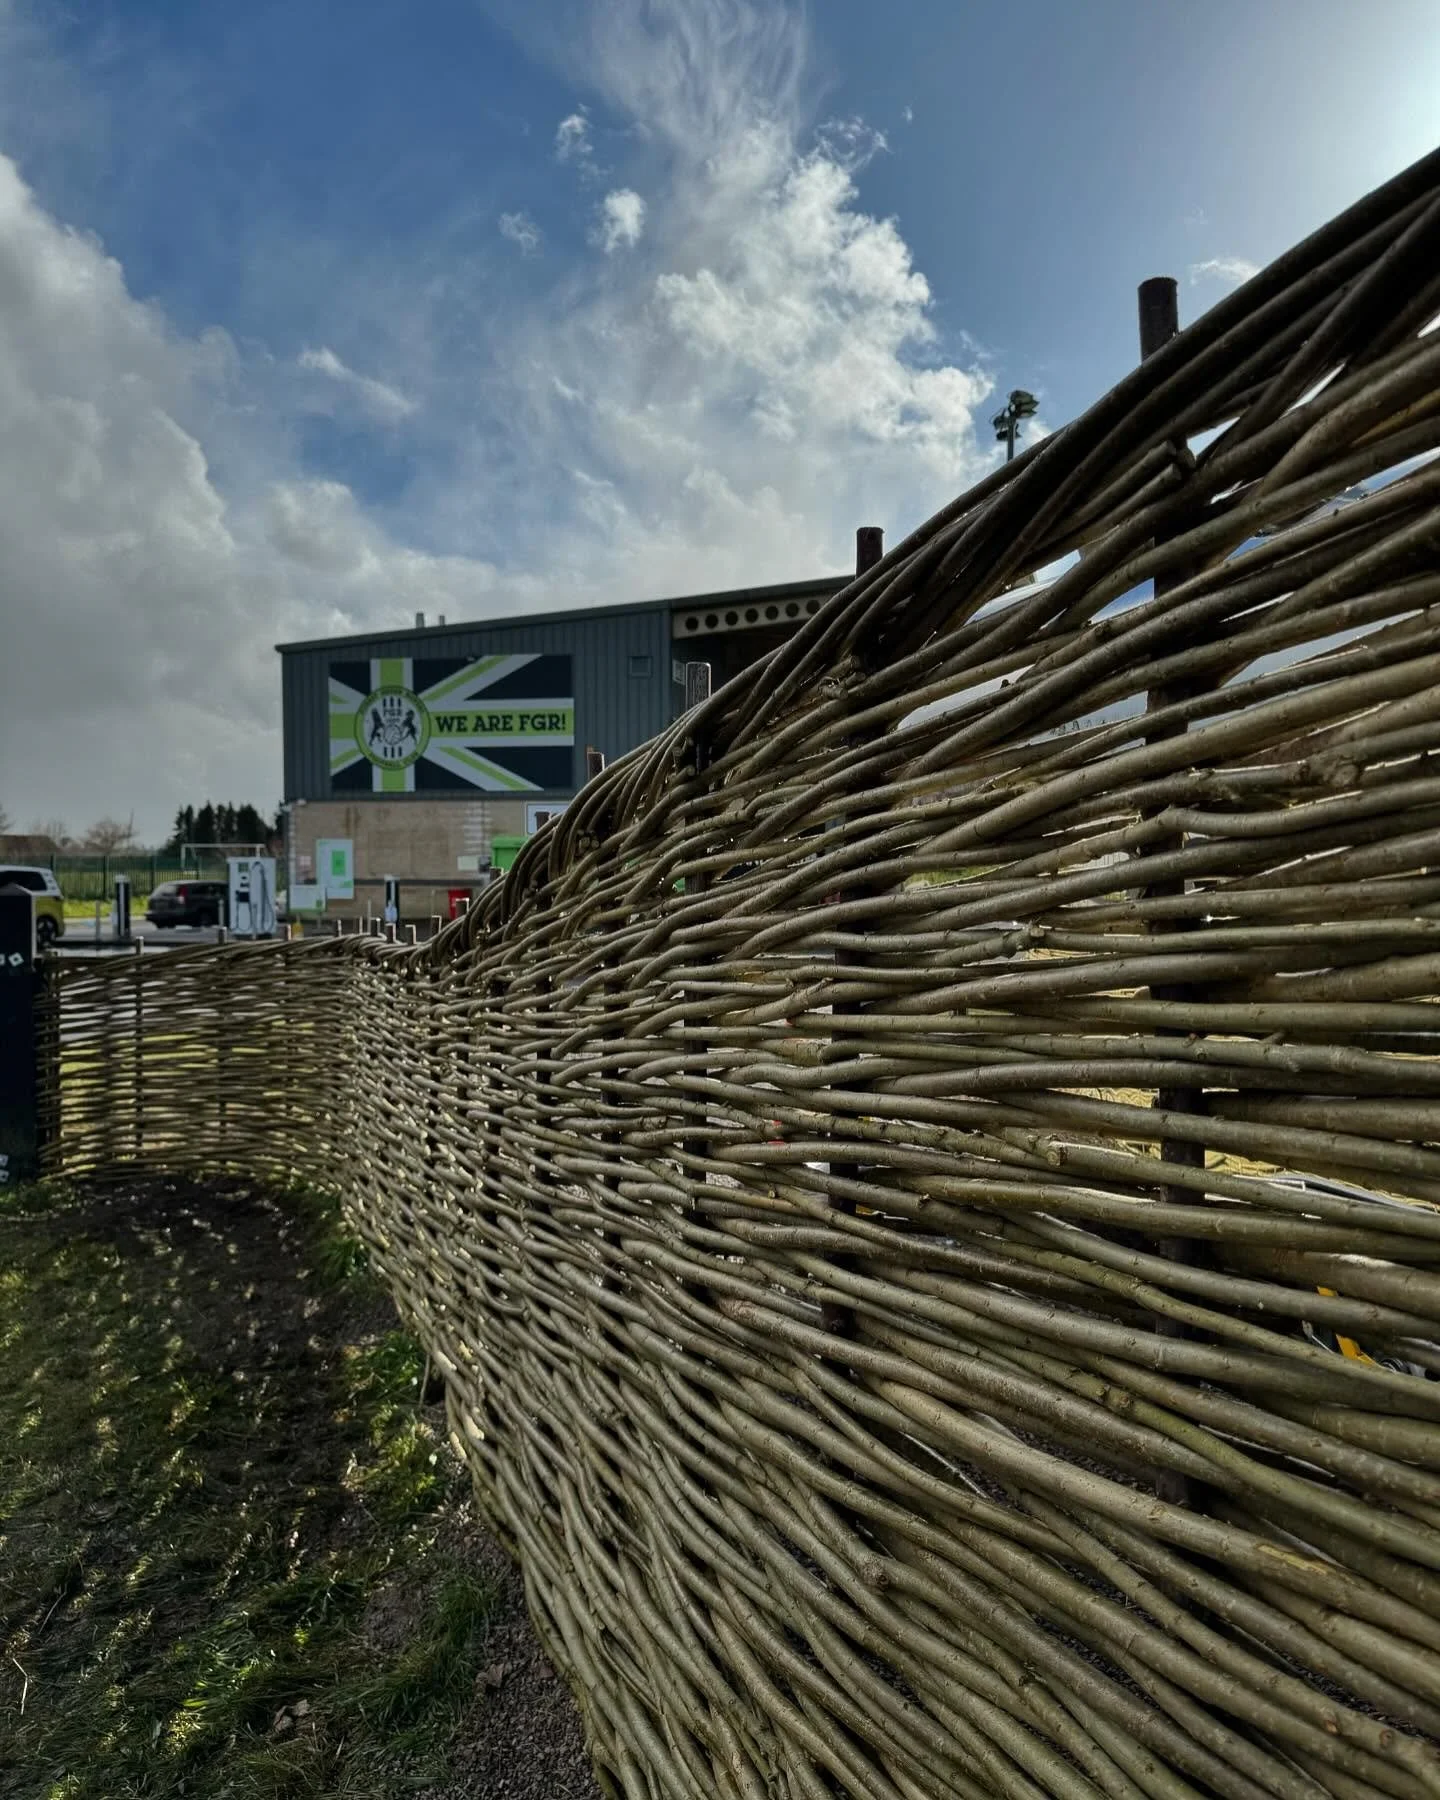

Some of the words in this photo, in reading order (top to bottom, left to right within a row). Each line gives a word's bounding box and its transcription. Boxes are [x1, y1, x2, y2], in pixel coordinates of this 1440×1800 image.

[435, 715, 468, 732] WE
[472, 715, 513, 732] ARE
[519, 713, 566, 731] FGR!
